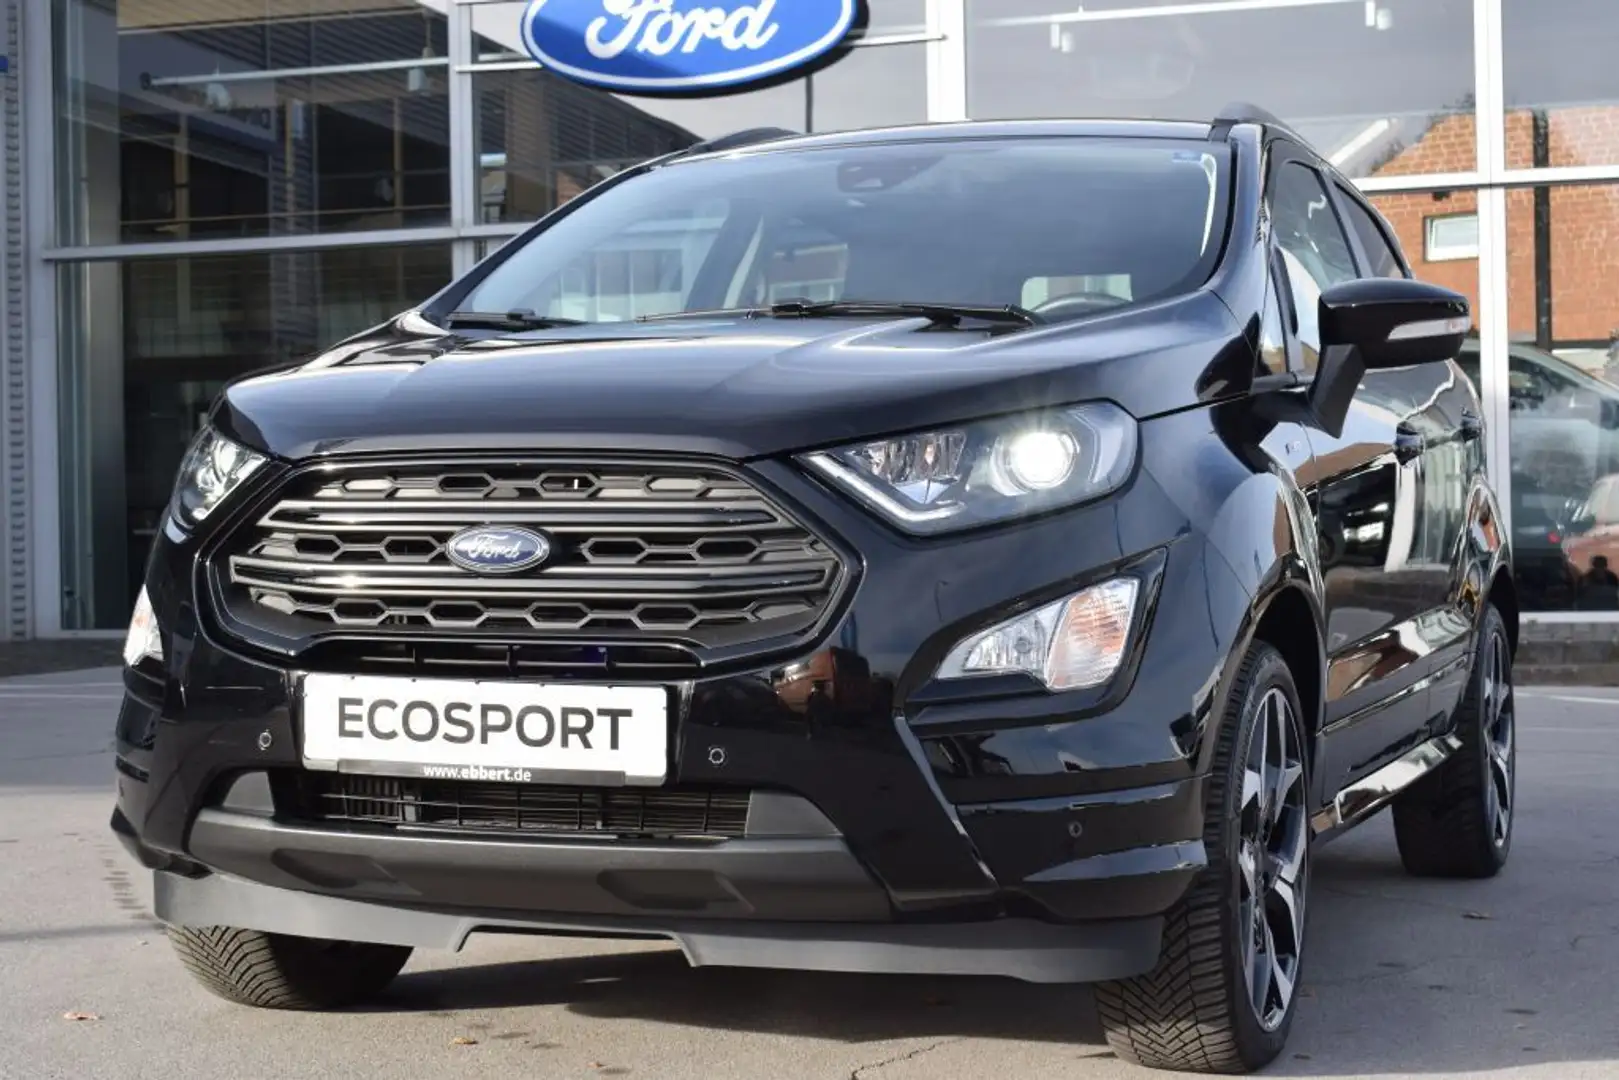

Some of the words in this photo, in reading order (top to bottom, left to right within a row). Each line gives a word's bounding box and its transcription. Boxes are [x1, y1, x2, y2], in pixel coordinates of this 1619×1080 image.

[584, 0, 779, 59] Ford
[467, 534, 521, 558] Ford
[337, 696, 633, 751] ECOSPORT
[423, 764, 532, 782] www.ebbert.de
